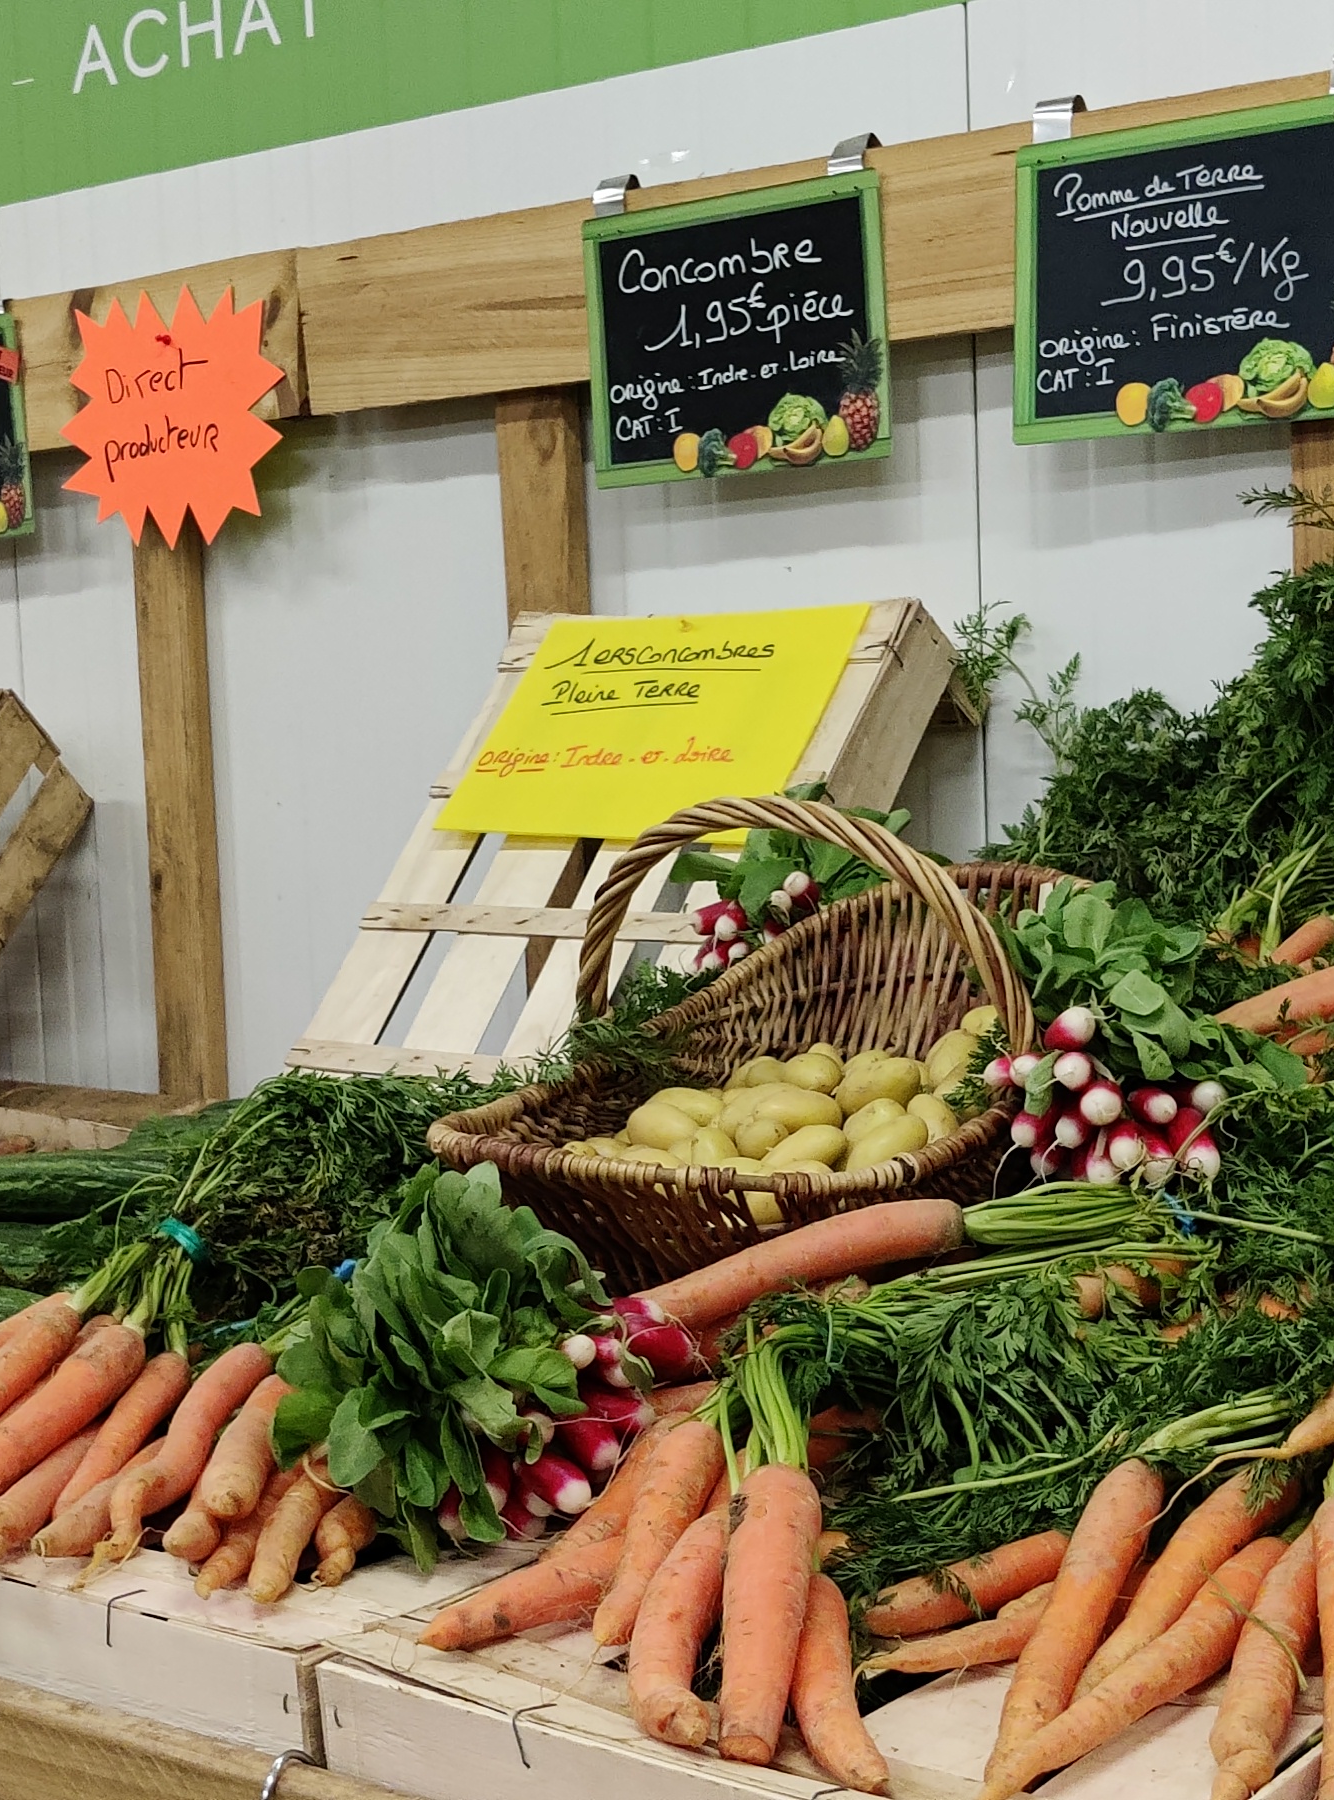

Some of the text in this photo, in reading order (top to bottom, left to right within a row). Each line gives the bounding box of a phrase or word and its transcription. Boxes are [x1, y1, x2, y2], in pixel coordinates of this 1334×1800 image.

[1053, 172, 1140, 218] Pomme
[1143, 174, 1177, 199] de
[1111, 201, 1229, 240] Nouvelle
[105, 348, 209, 404] Direct
[541, 680, 620, 706] Pleine
